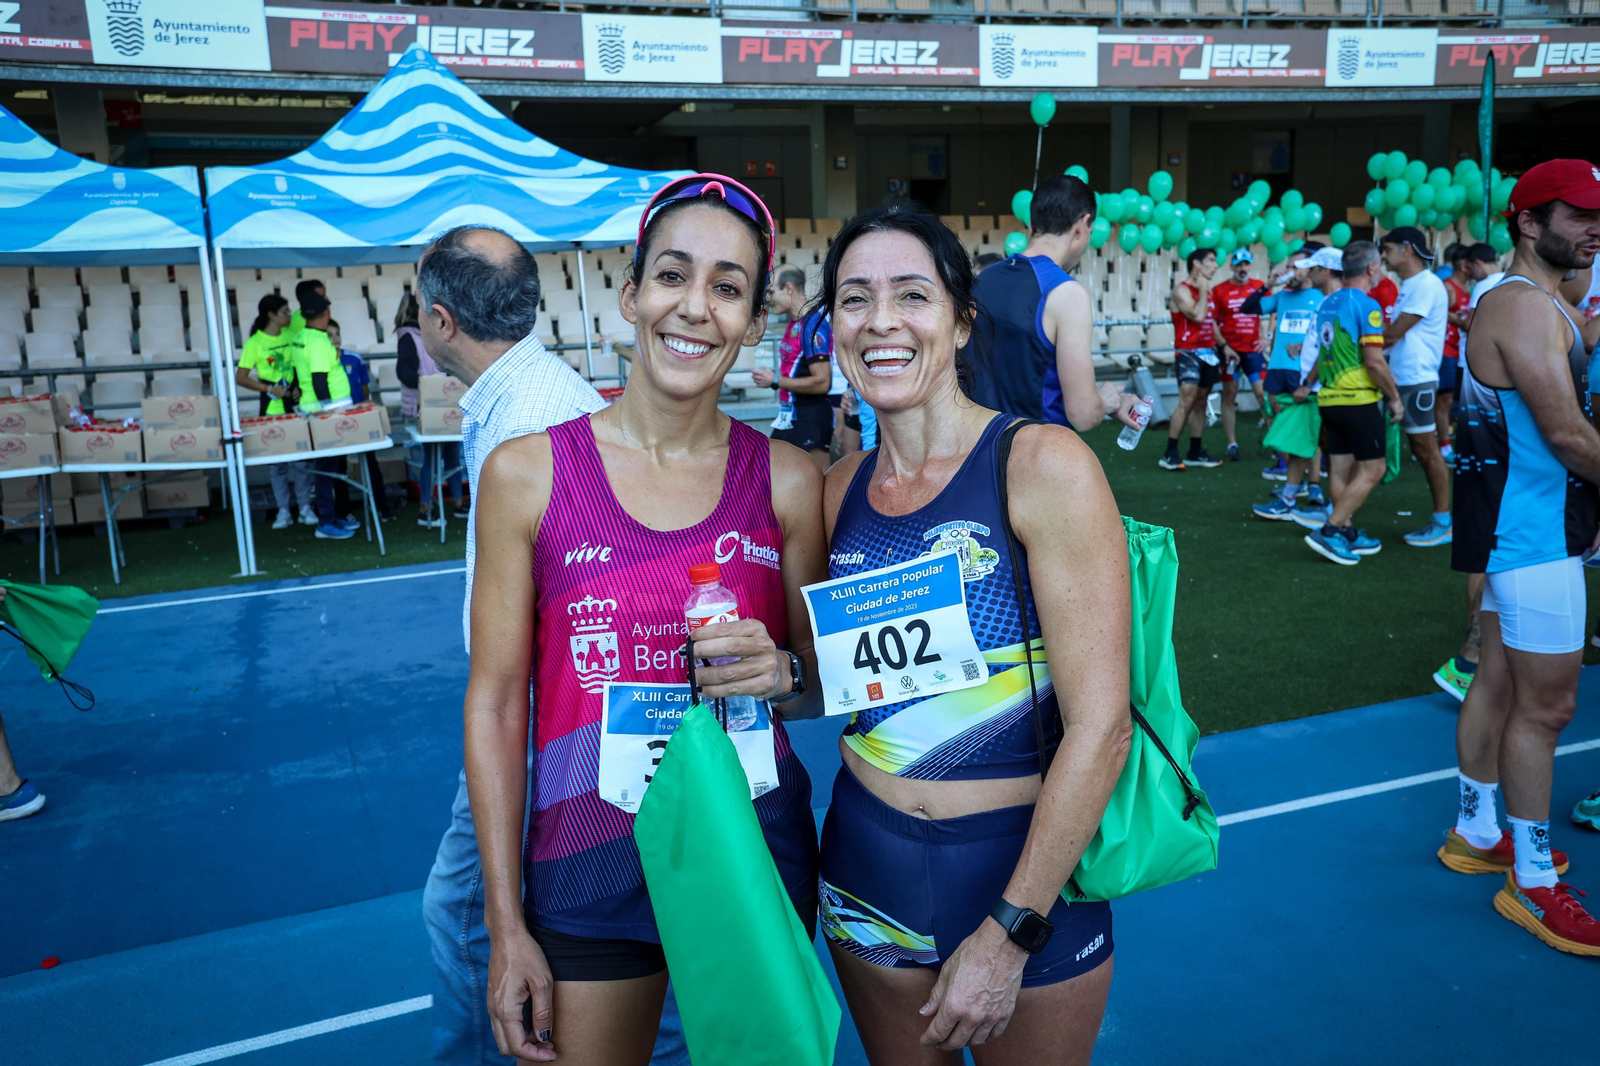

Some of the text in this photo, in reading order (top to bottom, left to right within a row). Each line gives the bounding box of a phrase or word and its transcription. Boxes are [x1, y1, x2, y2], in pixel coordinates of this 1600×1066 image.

[152, 18, 250, 34] Ayuntamiento
[28, 37, 82, 49] COMPITE.
[154, 32, 210, 45] de Jerez
[290, 15, 535, 67] PLAY JEREZ
[632, 40, 708, 53] Ayuntamiento
[632, 52, 676, 63] de Jerez
[738, 30, 940, 77] PLAY JEREZ
[1021, 48, 1086, 59] Ayuntamiento
[1112, 36, 1291, 80] PLAY JEREZ
[1364, 50, 1425, 61] Ayuntamiento
[1449, 35, 1600, 78] PLAY JERE
[1021, 58, 1058, 68] de Jerez
[1364, 59, 1398, 70] de Jerez
[924, 520, 990, 541] POLIDEPORTIVO OLIMPO
[564, 541, 612, 567] vive
[836, 550, 865, 566] rasán
[829, 564, 944, 601] XLIII Carrera Popular
[845, 586, 930, 614] Ciudad de Jerez
[870, 608, 897, 620] Noviembre
[905, 603, 918, 611] 2023
[631, 622, 688, 640] Ayunta
[853, 619, 942, 675] 402
[634, 644, 684, 671] Ben
[632, 691, 692, 702] XLIII Carr
[1513, 888, 1546, 921] HOKA
[1075, 932, 1105, 962] rasán
